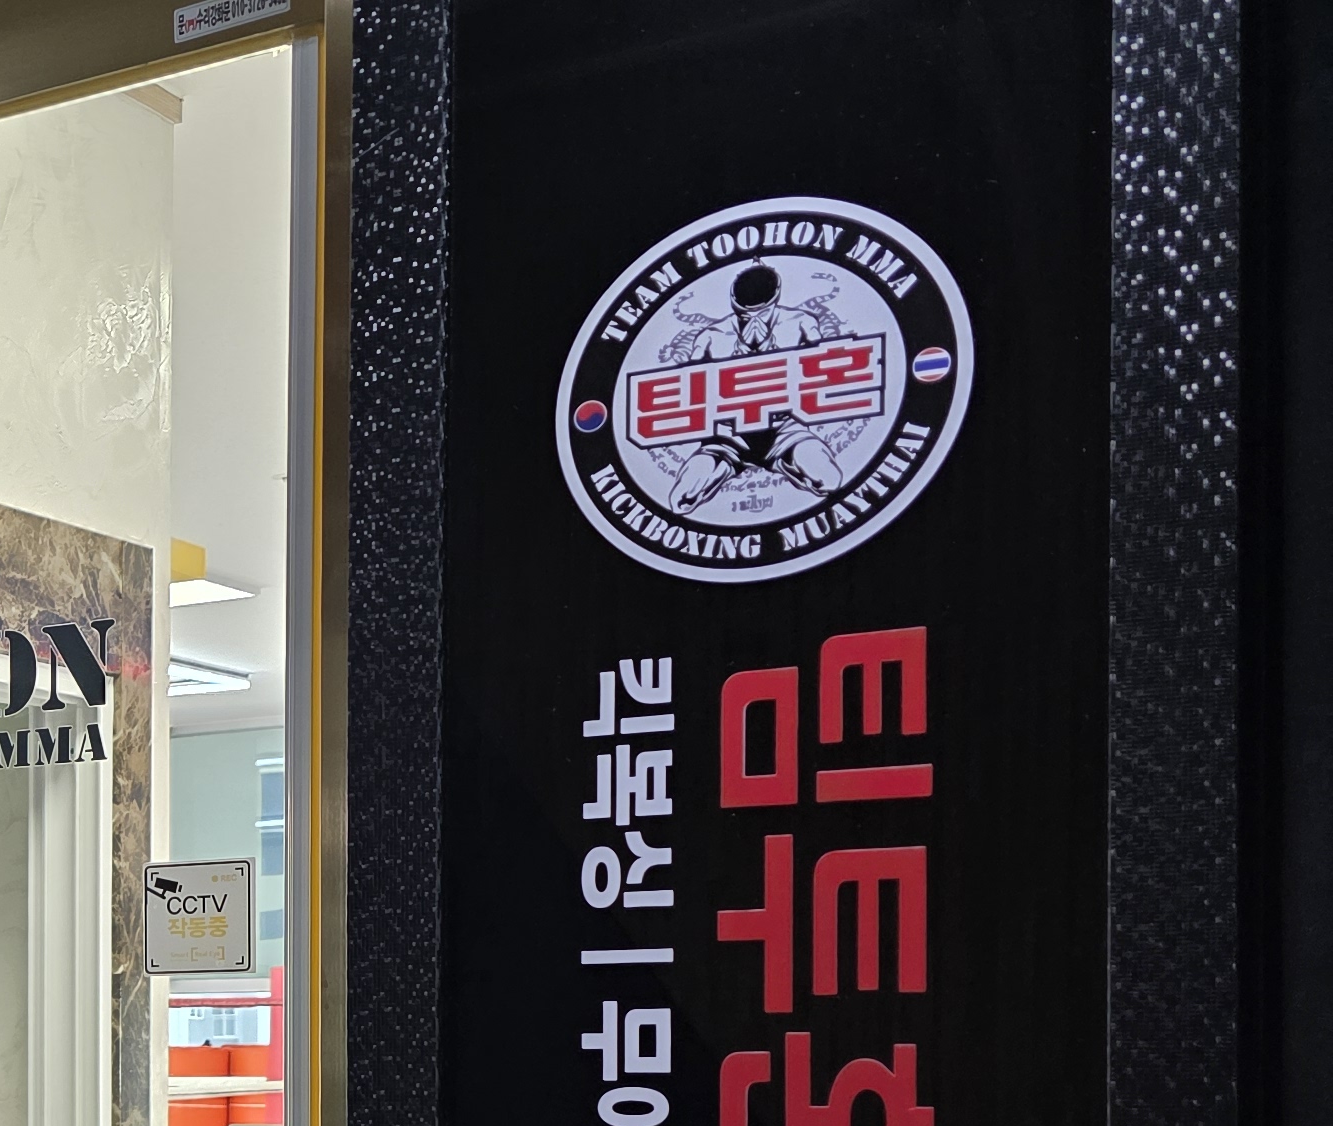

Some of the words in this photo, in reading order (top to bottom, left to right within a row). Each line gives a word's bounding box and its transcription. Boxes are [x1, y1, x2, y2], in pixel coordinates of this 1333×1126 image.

[600, 262, 683, 343] TEAM
[686, 221, 844, 270] TOOHON
[846, 233, 919, 299] MMA
[636, 345, 874, 439] 팀투혼
[589, 464, 761, 559] KICKBOXING
[778, 421, 931, 551] MUAYTHAI
[581, 656, 675, 909] 킥복싱
[166, 894, 228, 915] CCTV
[220, 873, 238, 882] REC
[167, 915, 229, 939] 작동중
